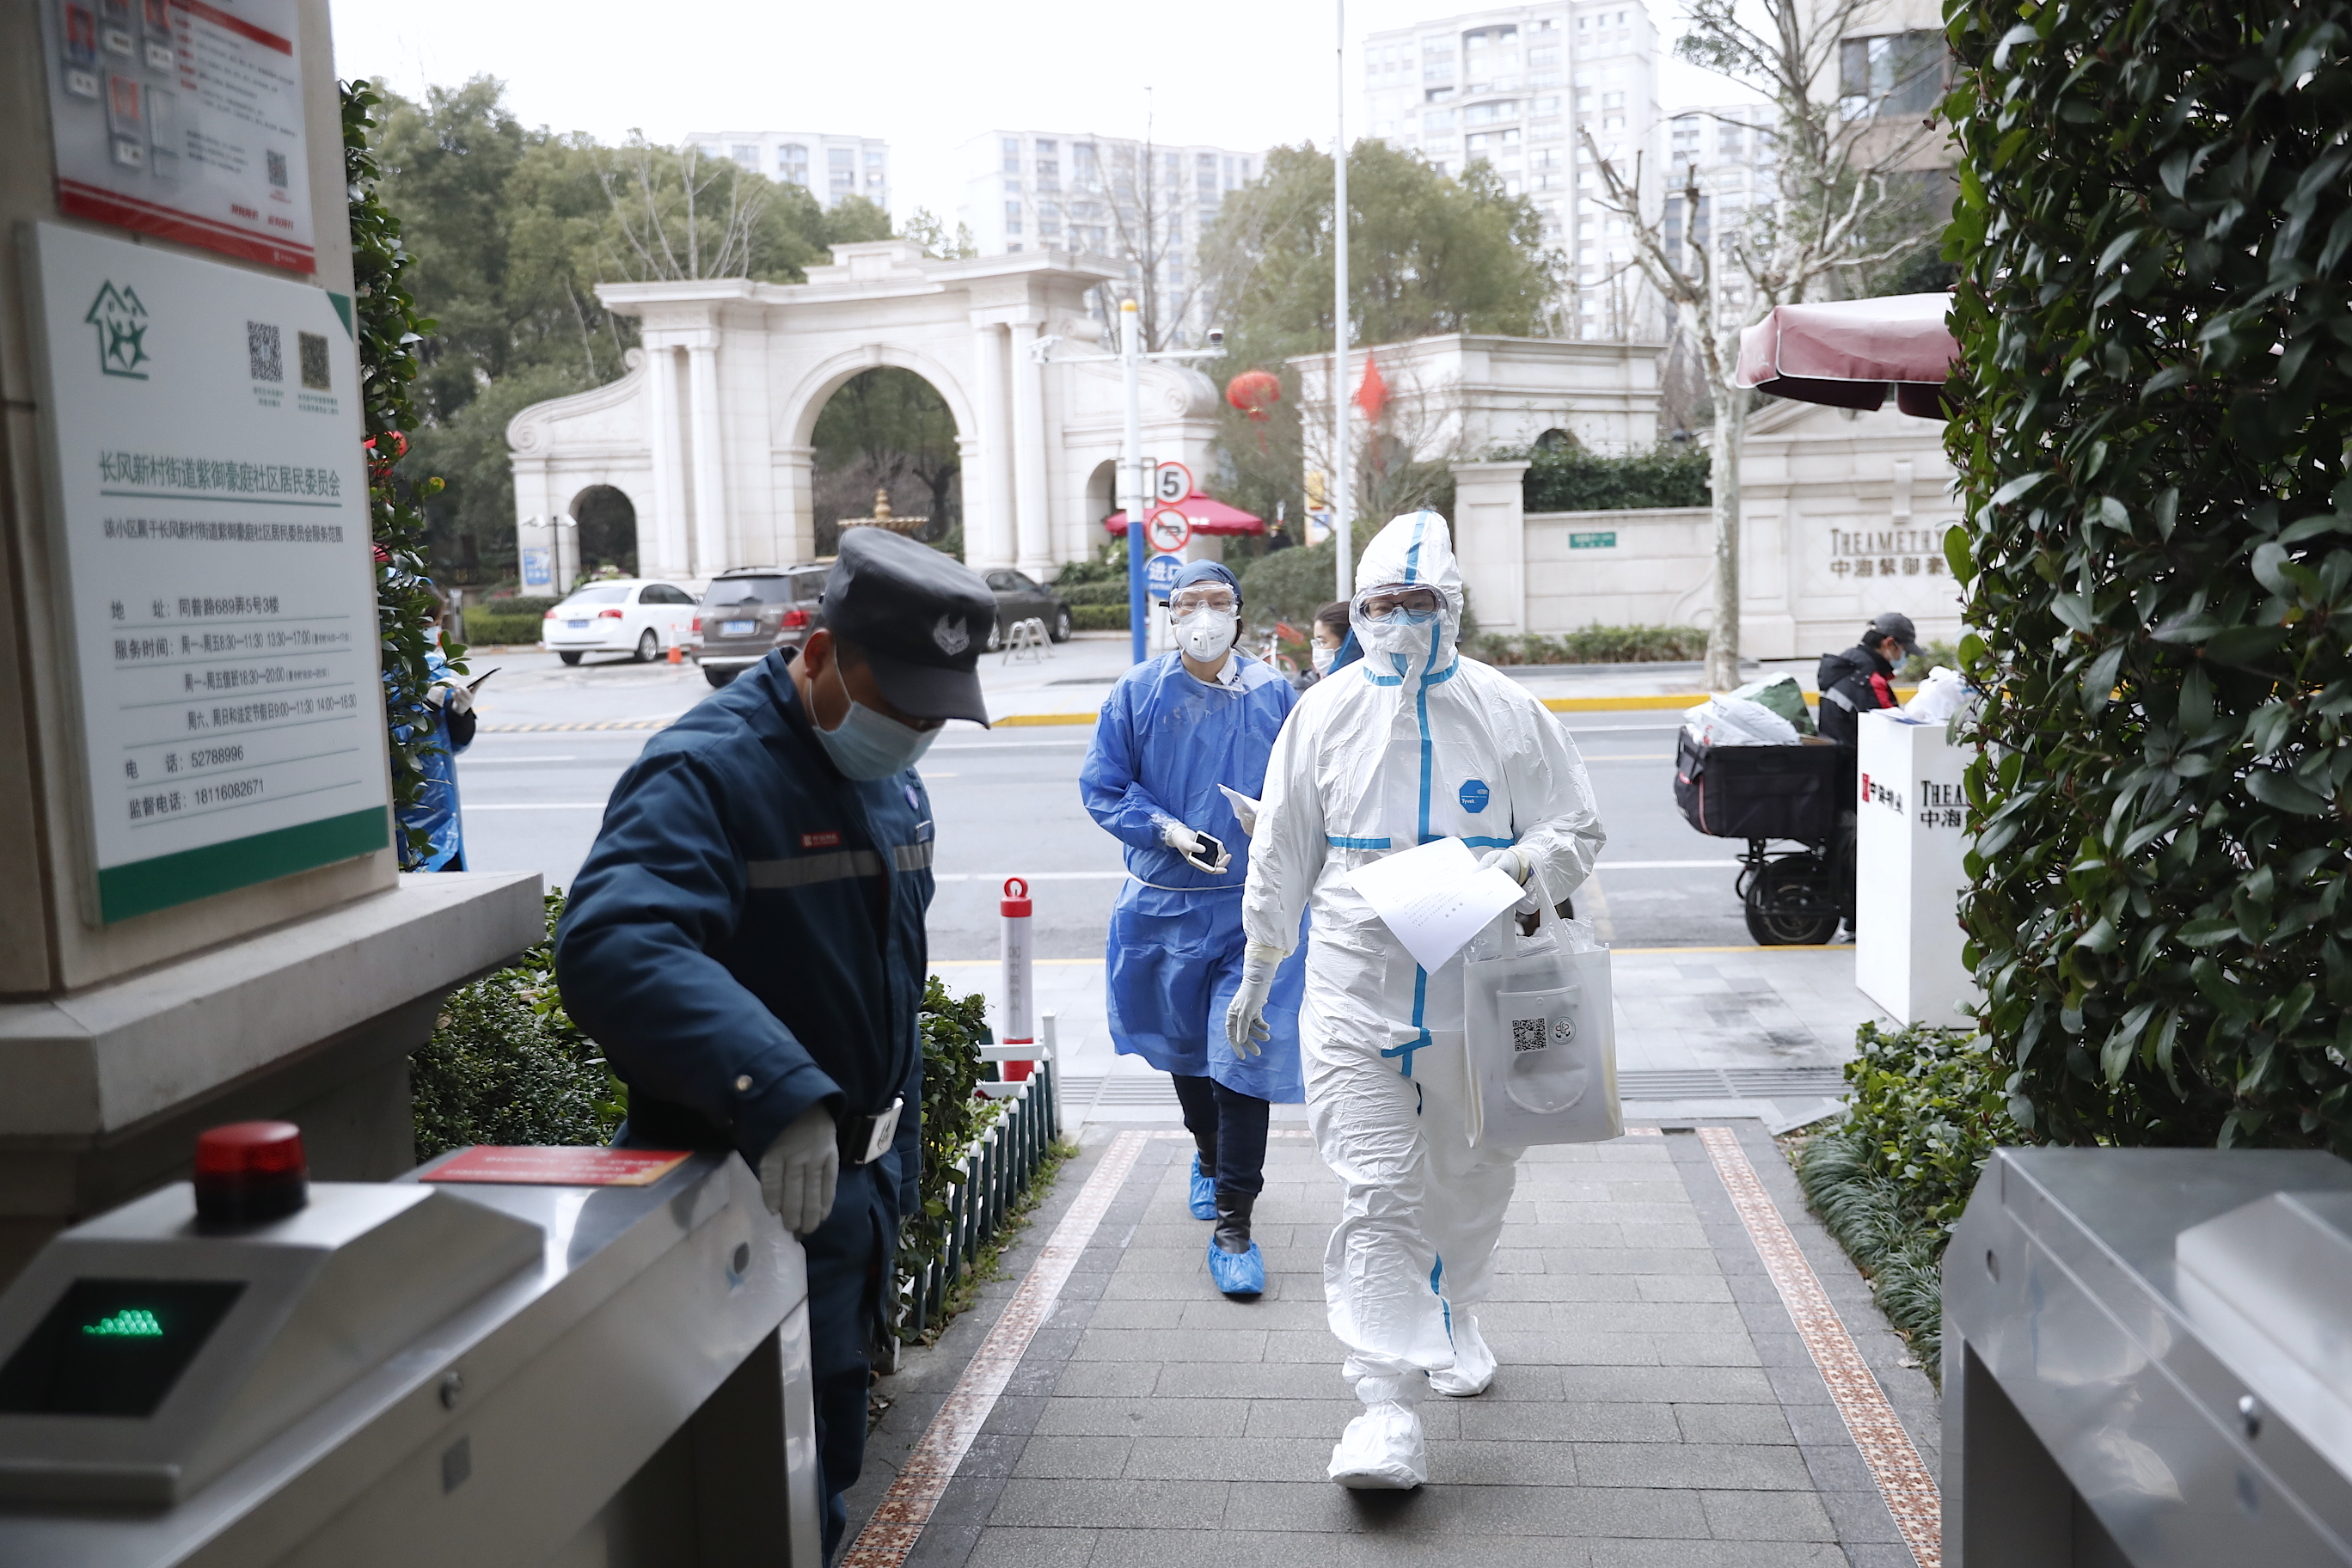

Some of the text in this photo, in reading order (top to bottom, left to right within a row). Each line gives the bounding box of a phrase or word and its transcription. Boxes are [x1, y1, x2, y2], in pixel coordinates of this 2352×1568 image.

[99, 451, 340, 497] 长风新村街道紫御豪庭社区居民委员会
[1162, 471, 1180, 496] 5
[1148, 561, 1183, 581] 进口
[1830, 557, 1945, 579] 中海紫御豪
[179, 597, 279, 617] 同普路689弄5号3楼
[191, 745, 244, 769] 52788996
[195, 778, 265, 805] 18116082671
[1920, 780, 1970, 806] THEA
[1920, 809, 1968, 828] 中海
